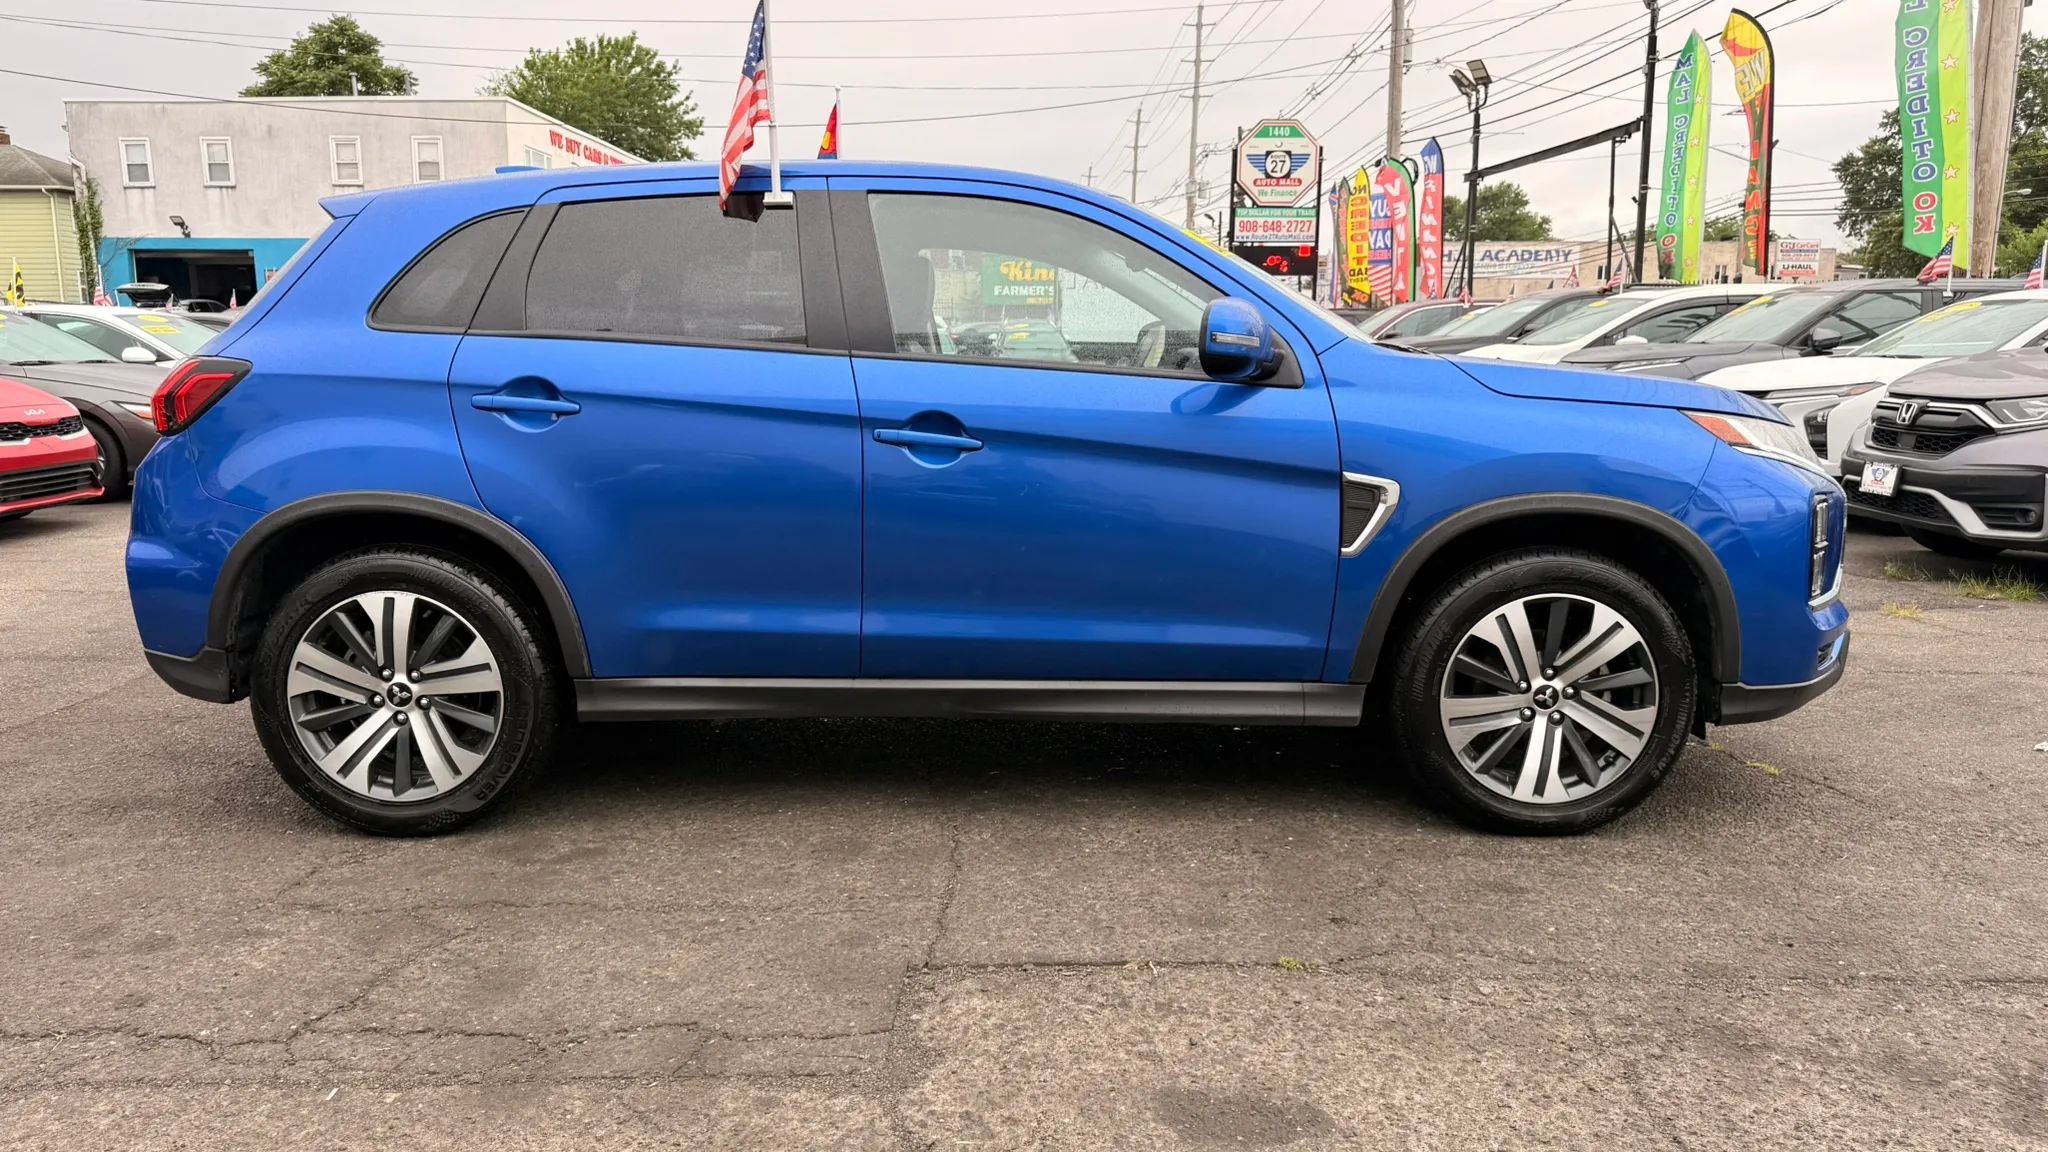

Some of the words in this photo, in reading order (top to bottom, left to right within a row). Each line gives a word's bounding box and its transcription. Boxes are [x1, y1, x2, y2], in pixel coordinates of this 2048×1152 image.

[1268, 126, 1290, 137] 1440
[549, 129, 563, 150] WE
[565, 136, 582, 157] BUY
[1270, 160, 1287, 174] 27
[1255, 178, 1277, 186] AUTO
[1279, 178, 1300, 186] MALL
[1257, 189, 1270, 197] We
[1271, 189, 1298, 197] Finance
[1238, 219, 1313, 233] 908-648-2727
[1480, 249, 1573, 263] ACADEMY
[994, 285, 1056, 297] FARMER'S
